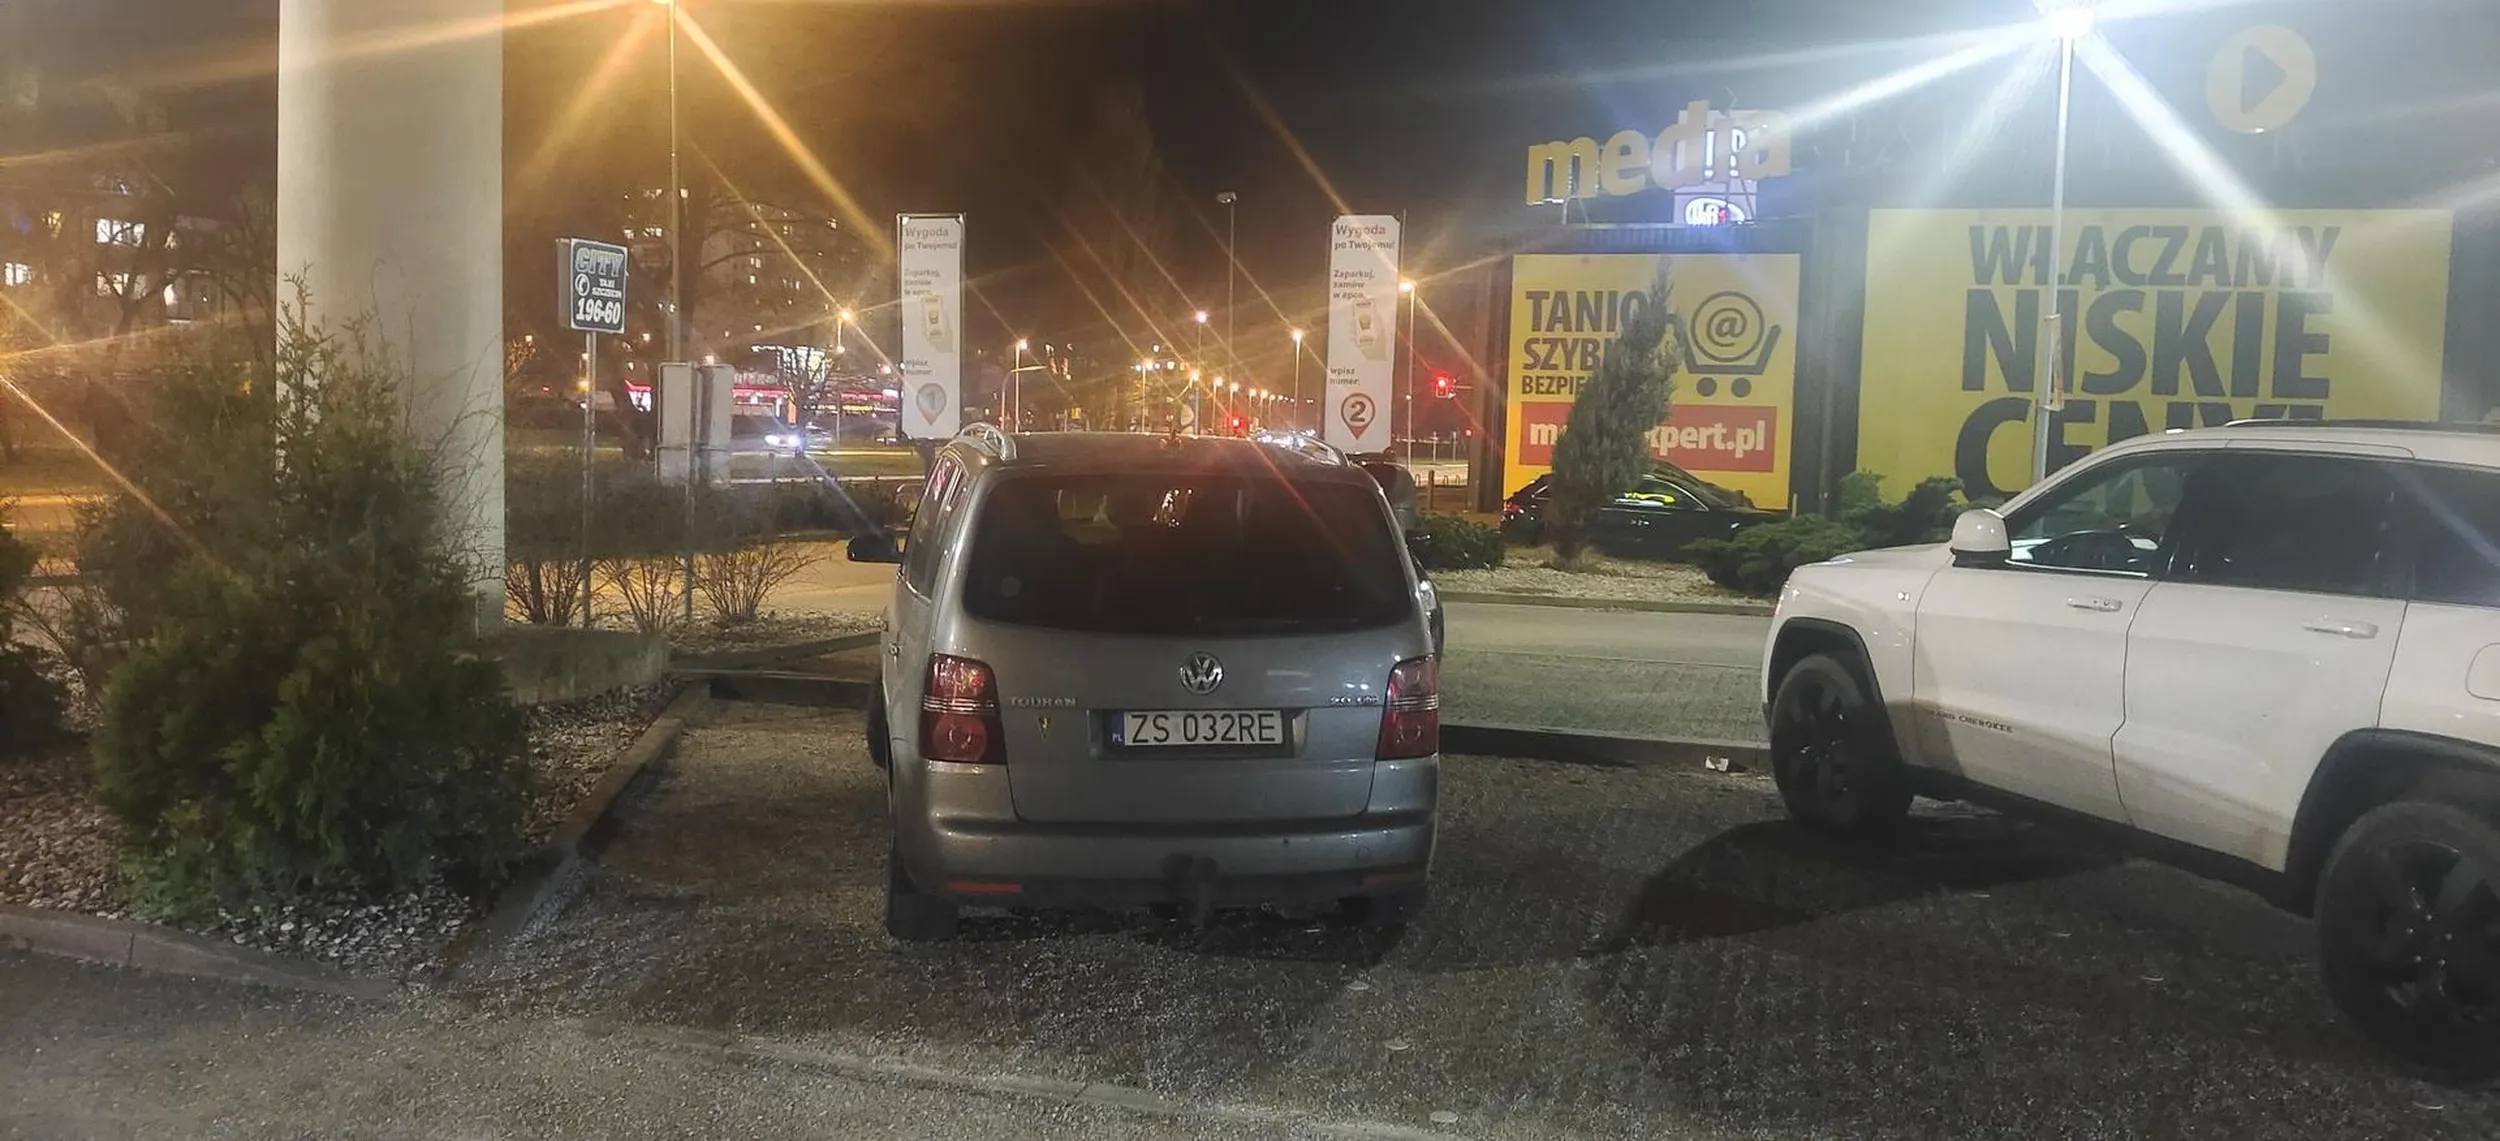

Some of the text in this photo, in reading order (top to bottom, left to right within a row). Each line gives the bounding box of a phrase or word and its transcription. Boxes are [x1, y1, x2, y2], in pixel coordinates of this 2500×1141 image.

[1526, 100, 1791, 206] media
[905, 227, 949, 239] Wygoda
[1335, 242, 1347, 250] po
[1336, 225, 1386, 238] Wygoda
[575, 248, 624, 277] CITY
[1968, 225, 2341, 291] WŁĄCZAMY
[576, 298, 621, 324] 196-60
[1962, 289, 2334, 399] NISKIE
[1350, 401, 1366, 422] 2
[1530, 420, 1765, 458] mxpert.pl
[1955, 397, 2323, 502] CE
[1112, 733, 1123, 742] PL
[1131, 713, 1276, 743] ZS 032RE
